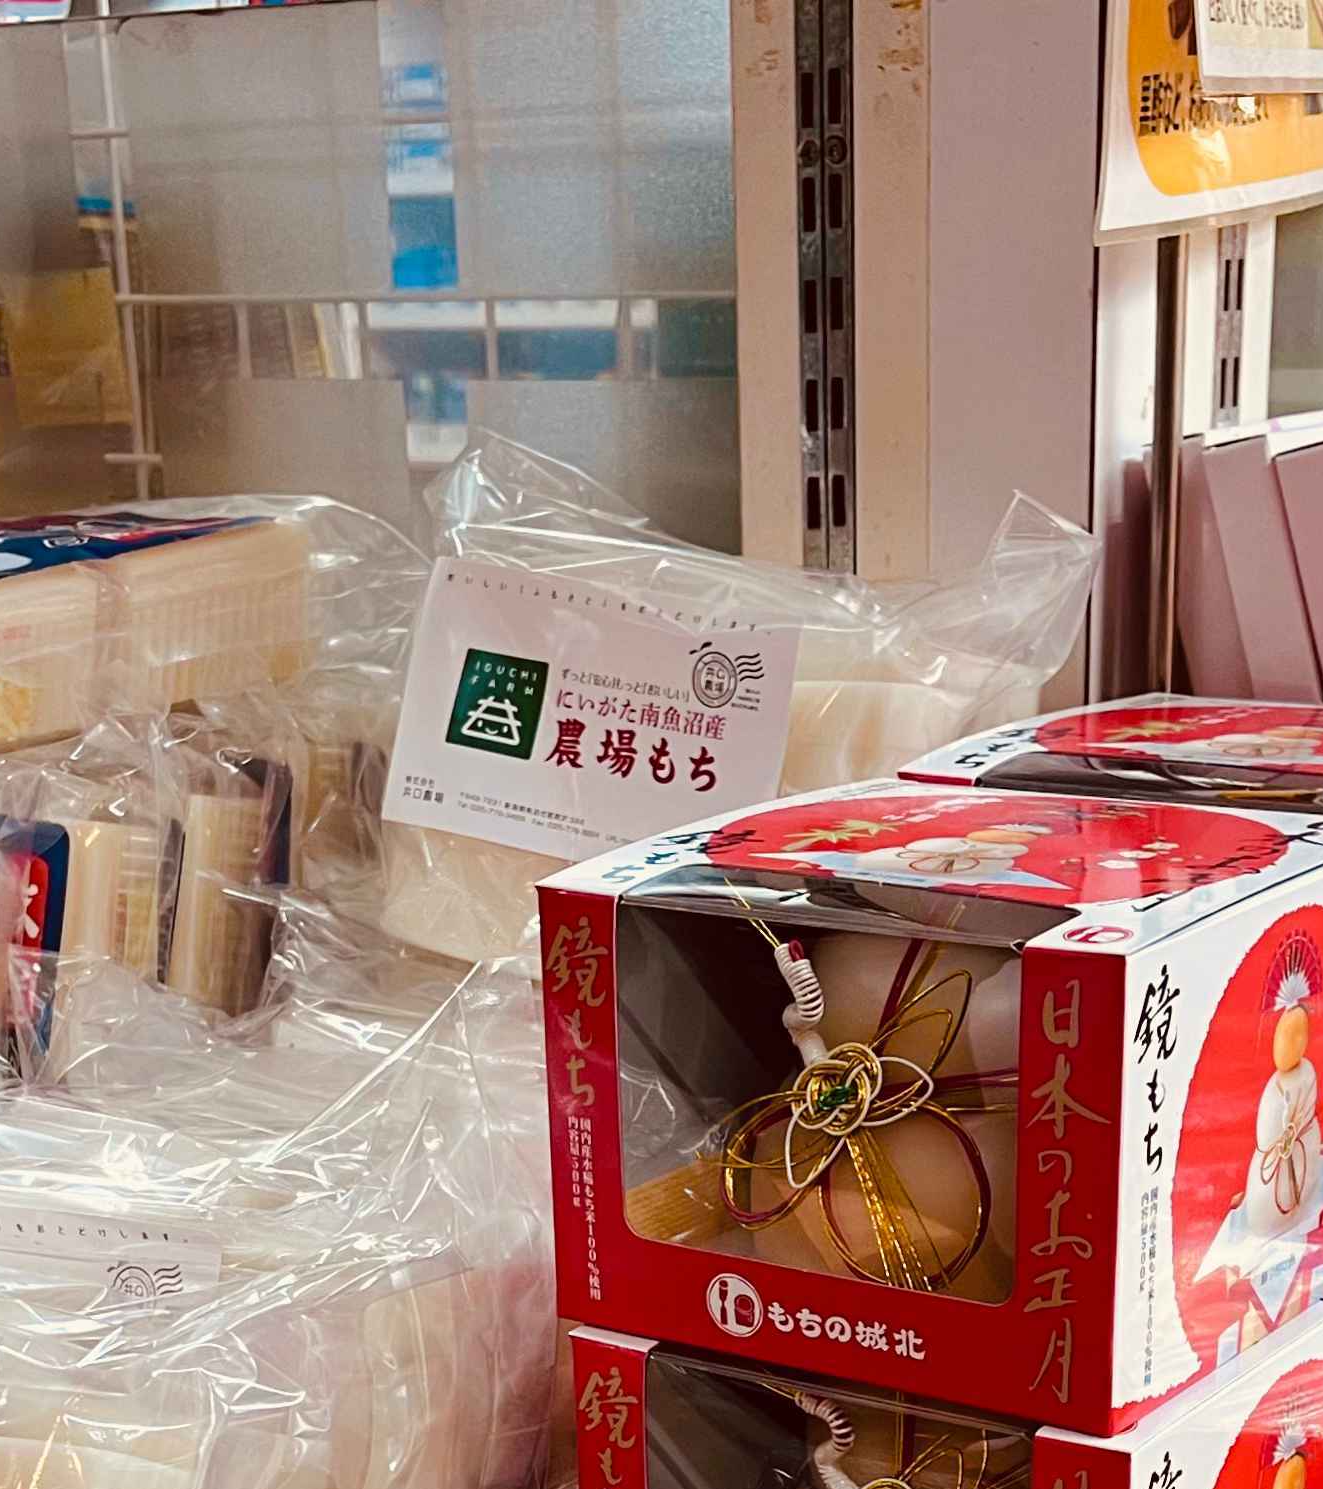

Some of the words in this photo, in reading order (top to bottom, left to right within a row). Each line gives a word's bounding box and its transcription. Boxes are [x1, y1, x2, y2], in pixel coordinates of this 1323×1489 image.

[545, 718, 718, 793] 農場もち
[556, 689, 728, 742] にいがた南魚沼産
[545, 915, 609, 1106] 鏡もち
[1132, 964, 1181, 1176] 鏡もち
[1025, 977, 1112, 1405] 日本のお正月
[766, 1301, 927, 1360] もちの城北
